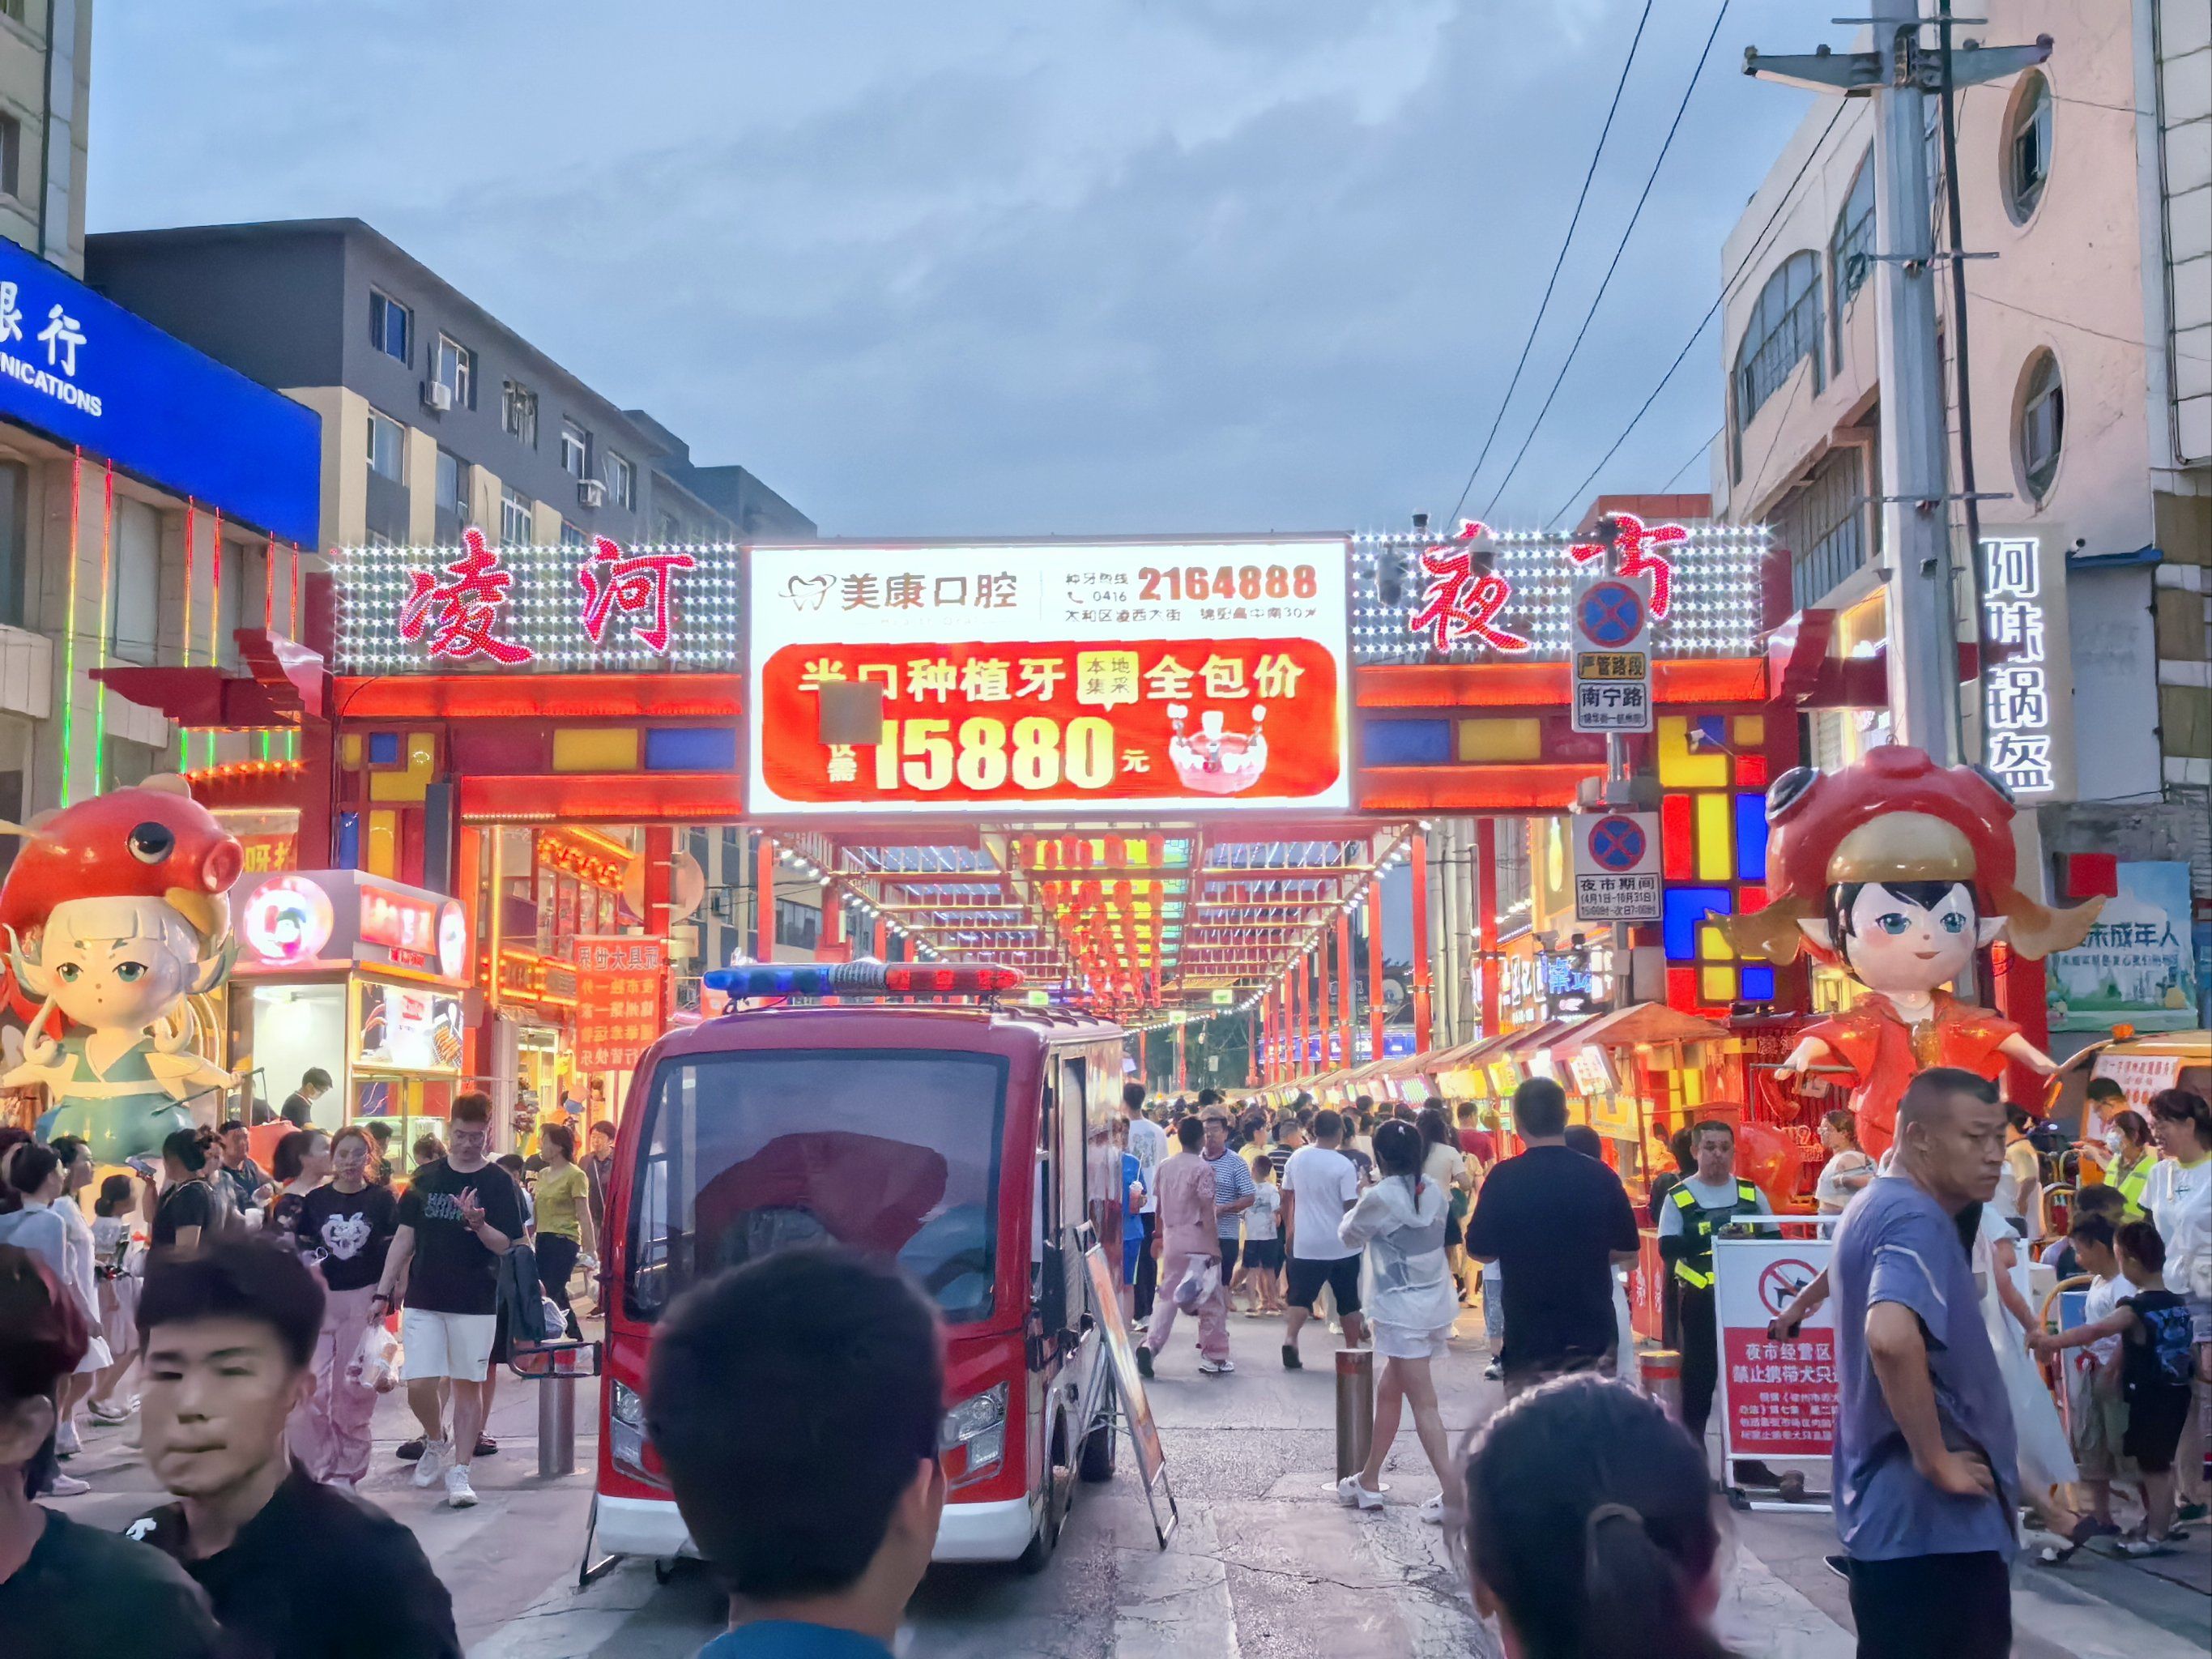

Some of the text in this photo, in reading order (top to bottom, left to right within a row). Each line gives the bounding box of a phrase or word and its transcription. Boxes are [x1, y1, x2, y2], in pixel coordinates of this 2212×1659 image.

[841, 571, 1017, 611] 美康口腔
[1137, 565, 1317, 601] 2164888
[1093, 591, 1127, 603] 0416
[1086, 657, 1131, 674] 本地
[1086, 677, 1130, 695] 集采
[1143, 654, 1306, 700] 全包价
[1582, 687, 1643, 708] 南宁路
[876, 716, 1151, 791] 15880 元
[1580, 877, 1655, 891] 夜市期间
[2081, 920, 2180, 948] 未成年人
[1745, 1342, 1831, 1361] 夜市经营区
